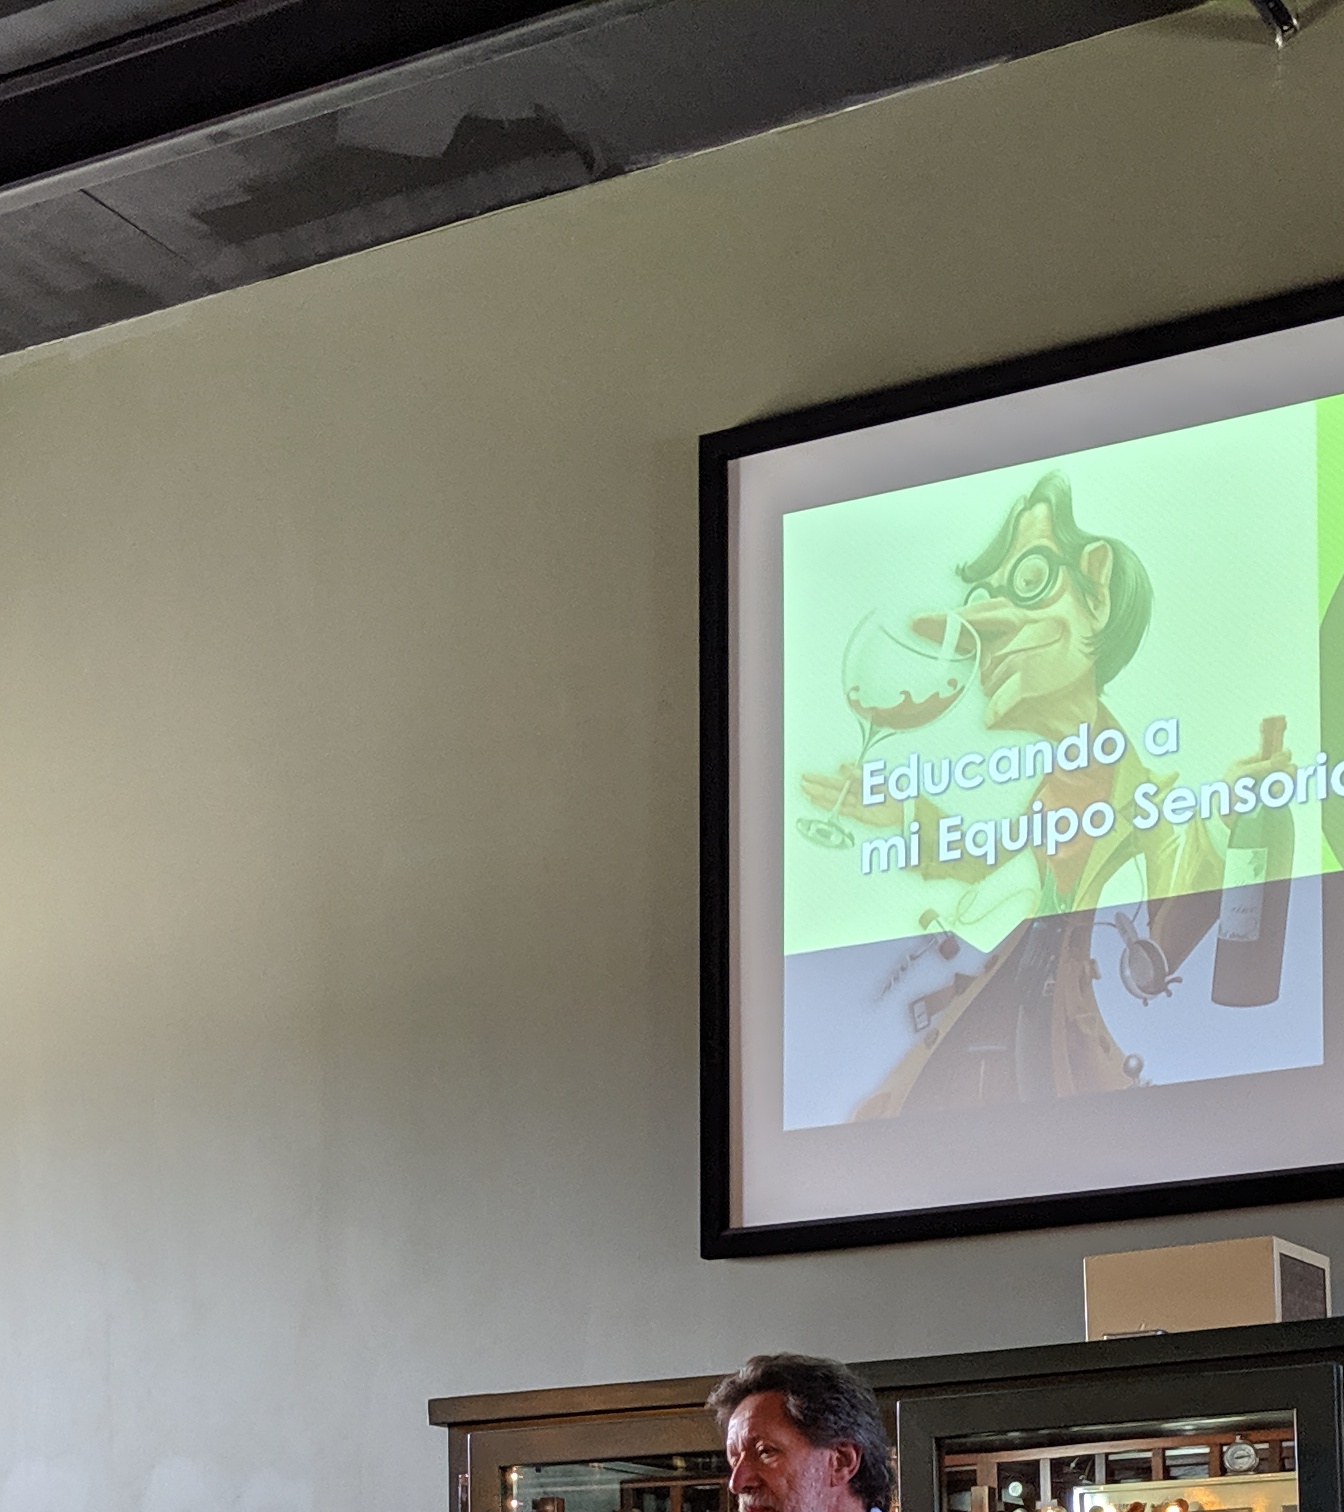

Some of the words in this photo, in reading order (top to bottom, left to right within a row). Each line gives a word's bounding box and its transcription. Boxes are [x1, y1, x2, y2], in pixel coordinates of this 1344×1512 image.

[860, 722, 1128, 806] Educando
[1143, 716, 1181, 757] a
[860, 822, 920, 875] mi
[937, 800, 1116, 866] Equipo
